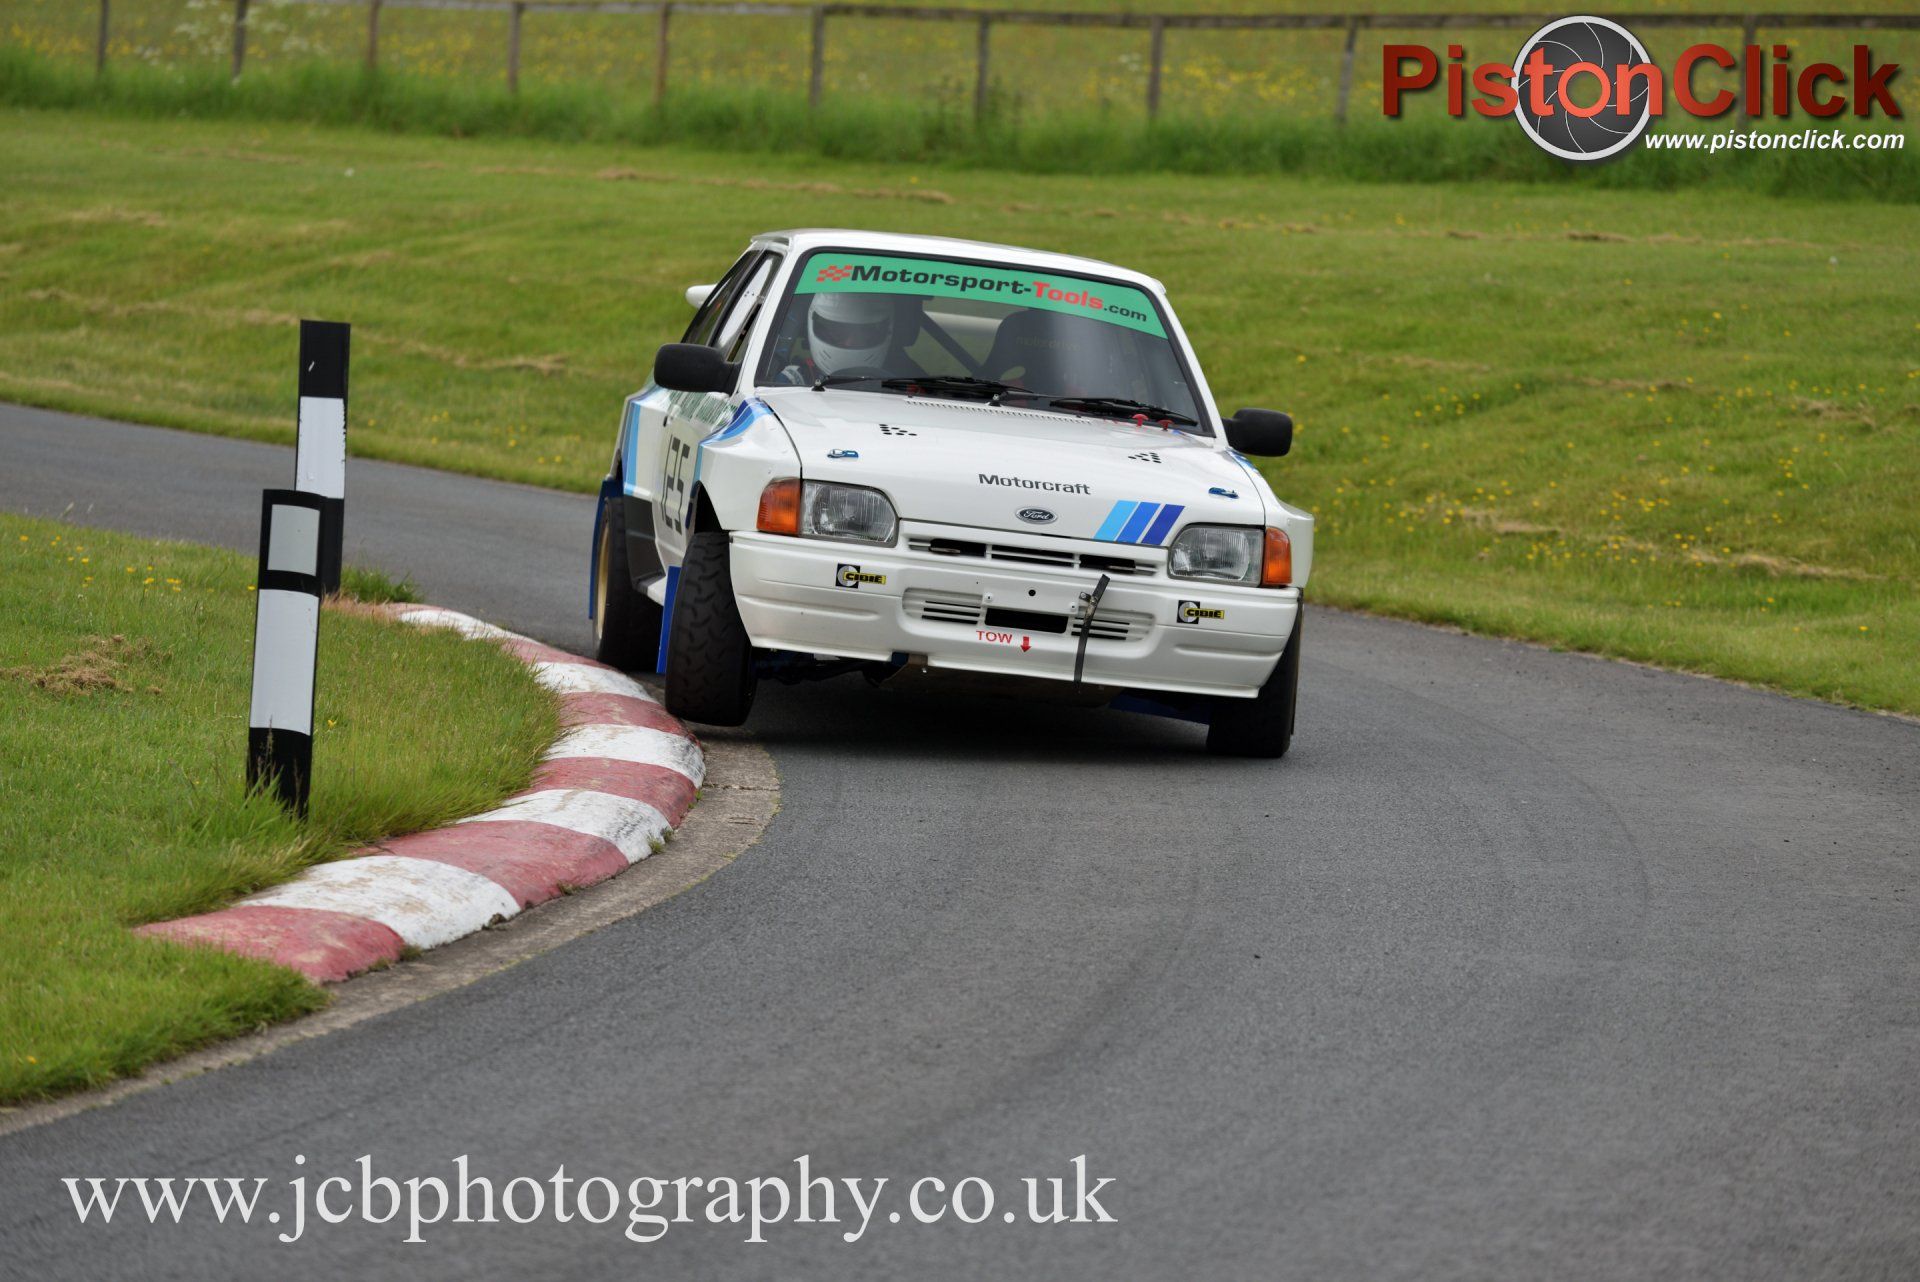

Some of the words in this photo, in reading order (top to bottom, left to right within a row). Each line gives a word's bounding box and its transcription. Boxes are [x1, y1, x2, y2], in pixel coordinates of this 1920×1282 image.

[851, 264, 1148, 323] Motorsport-Tools.com
[978, 473, 1091, 495] Motorcraft
[976, 630, 1013, 645] TOW
